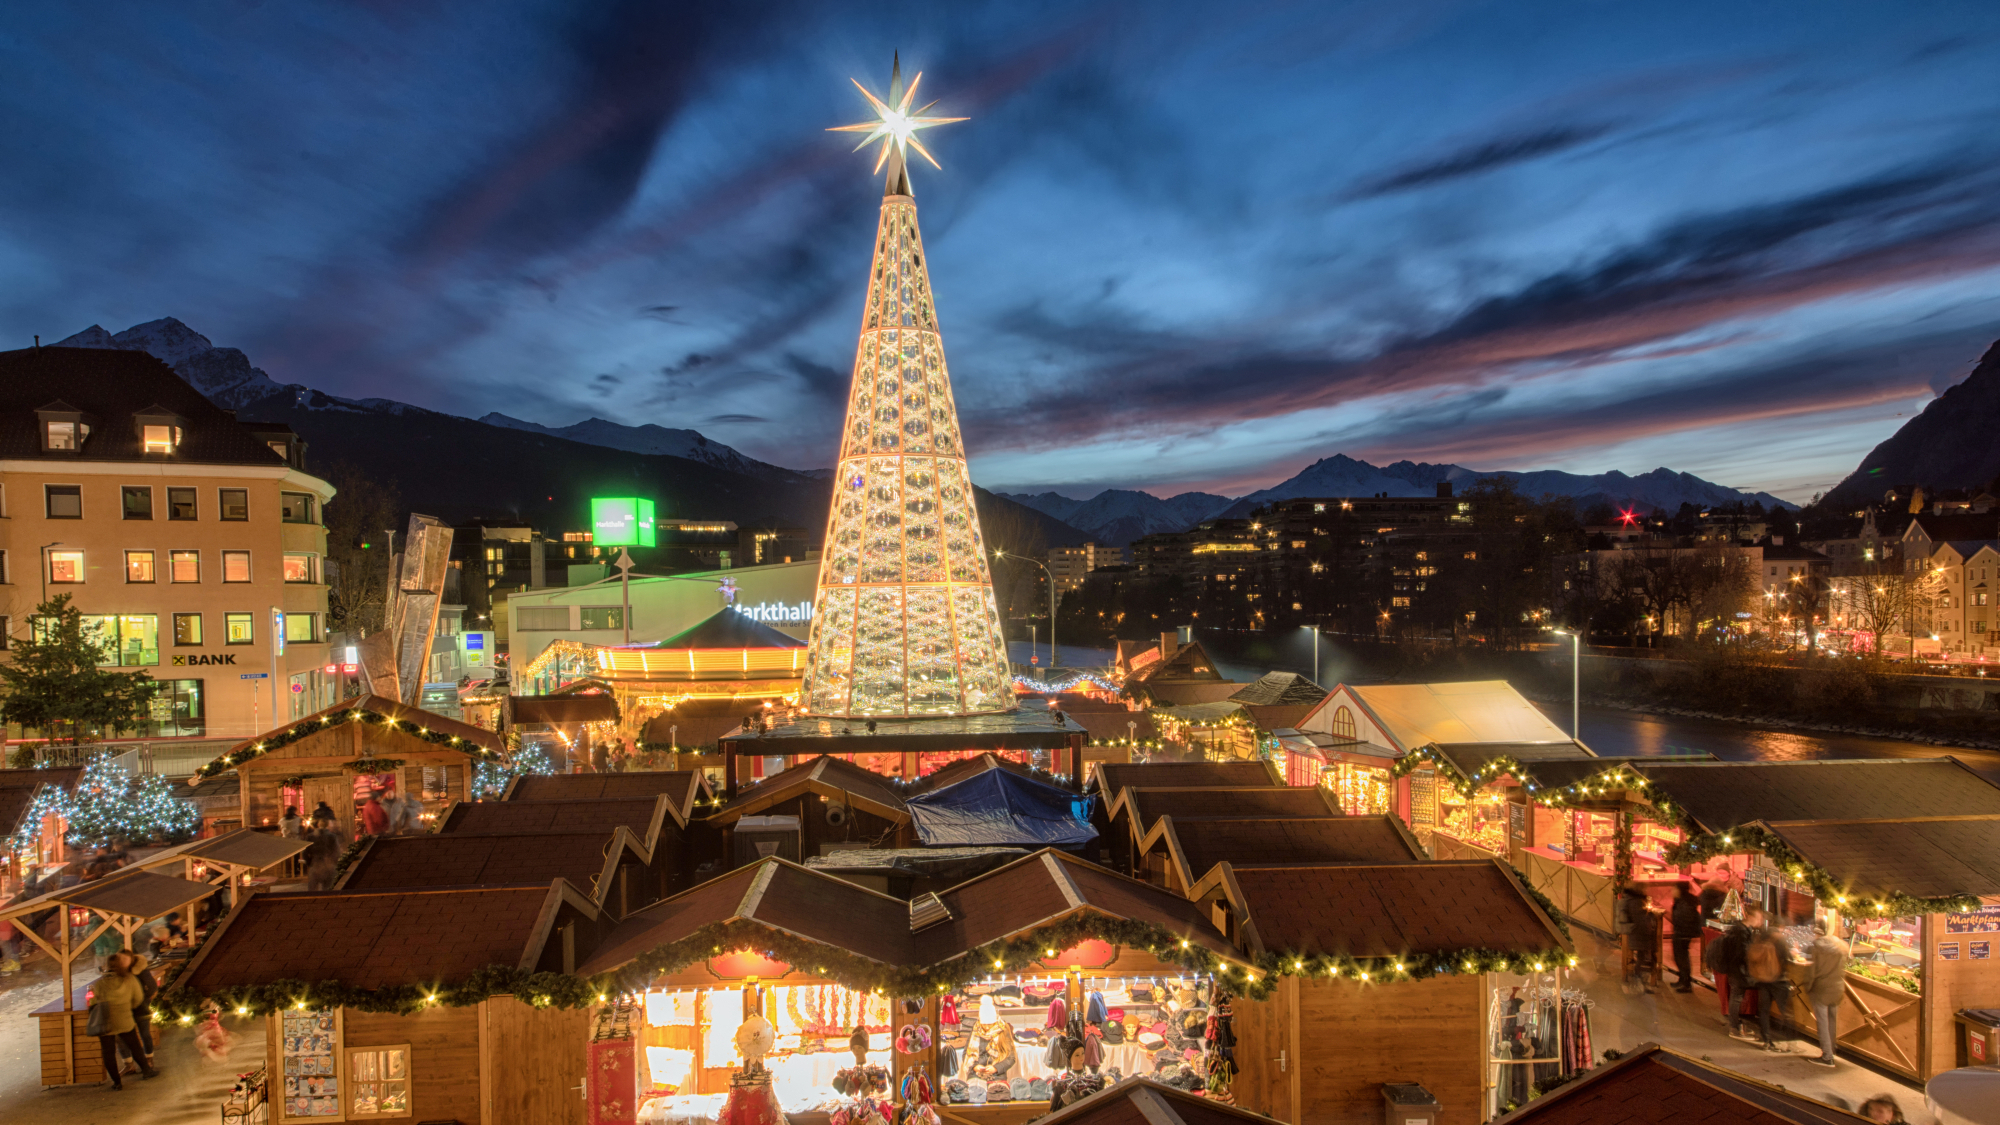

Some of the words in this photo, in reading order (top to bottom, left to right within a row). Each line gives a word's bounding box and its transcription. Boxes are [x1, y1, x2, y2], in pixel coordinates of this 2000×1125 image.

[736, 601, 816, 621] arkthall
[789, 620, 801, 628] der
[188, 654, 237, 666] BANK
[1948, 914, 2000, 925] Marktpfan
